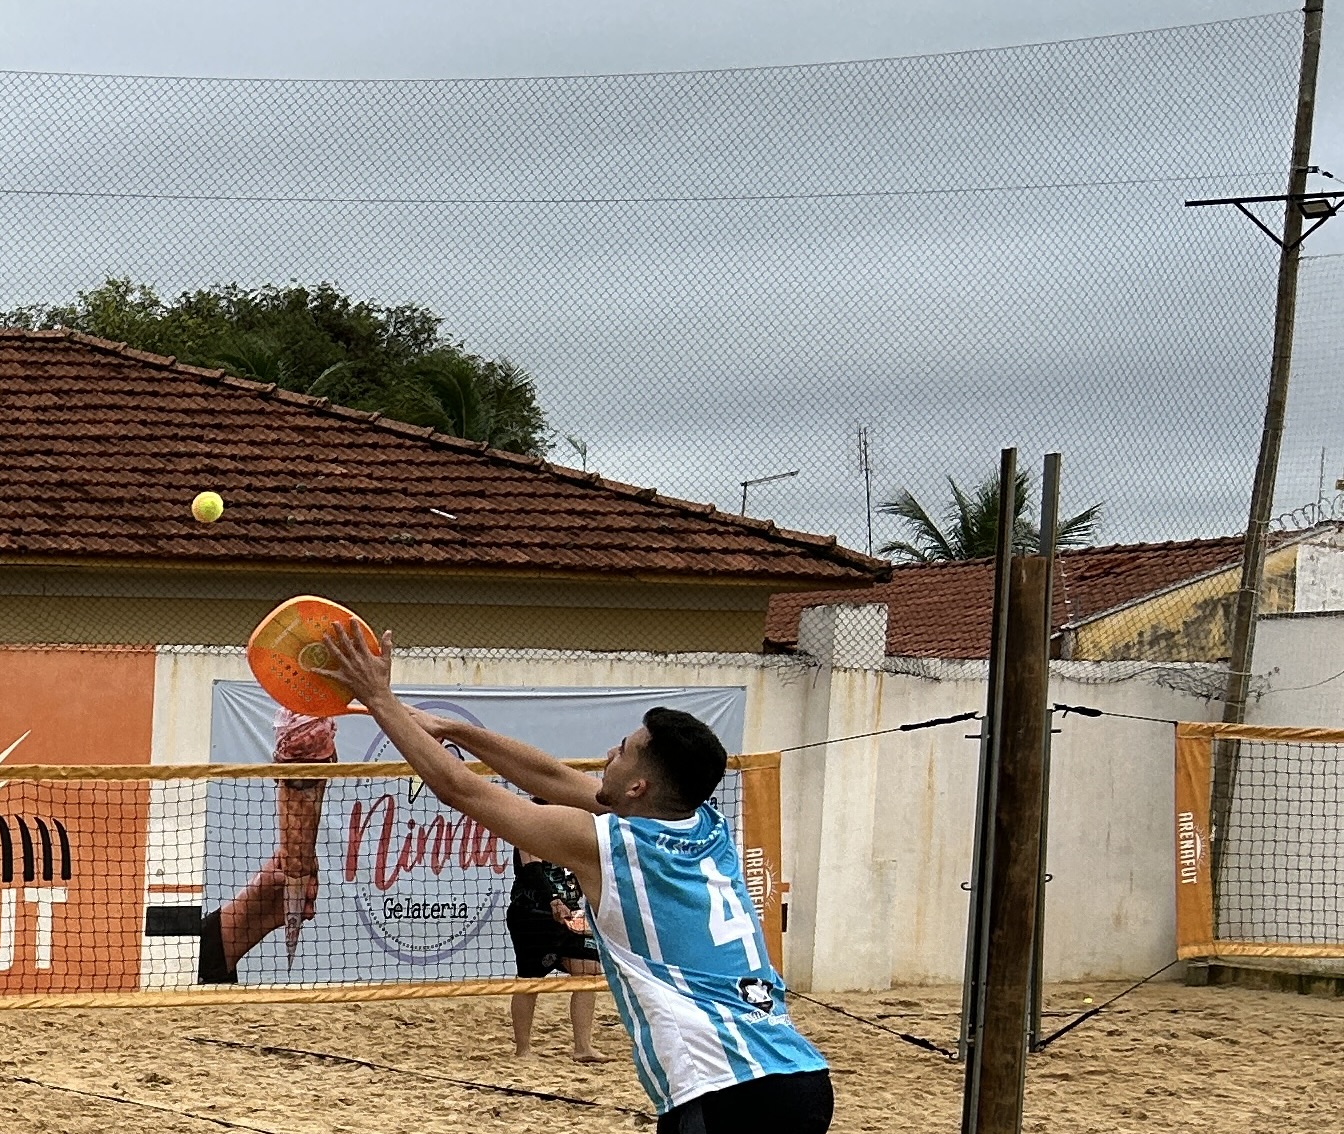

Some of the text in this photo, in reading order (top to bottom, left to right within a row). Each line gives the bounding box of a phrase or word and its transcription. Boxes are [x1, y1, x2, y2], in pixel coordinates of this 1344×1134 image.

[1179, 812, 1197, 884] ARENAFUT
[383, 897, 469, 919] Gelateria
[699, 856, 762, 971] 4
